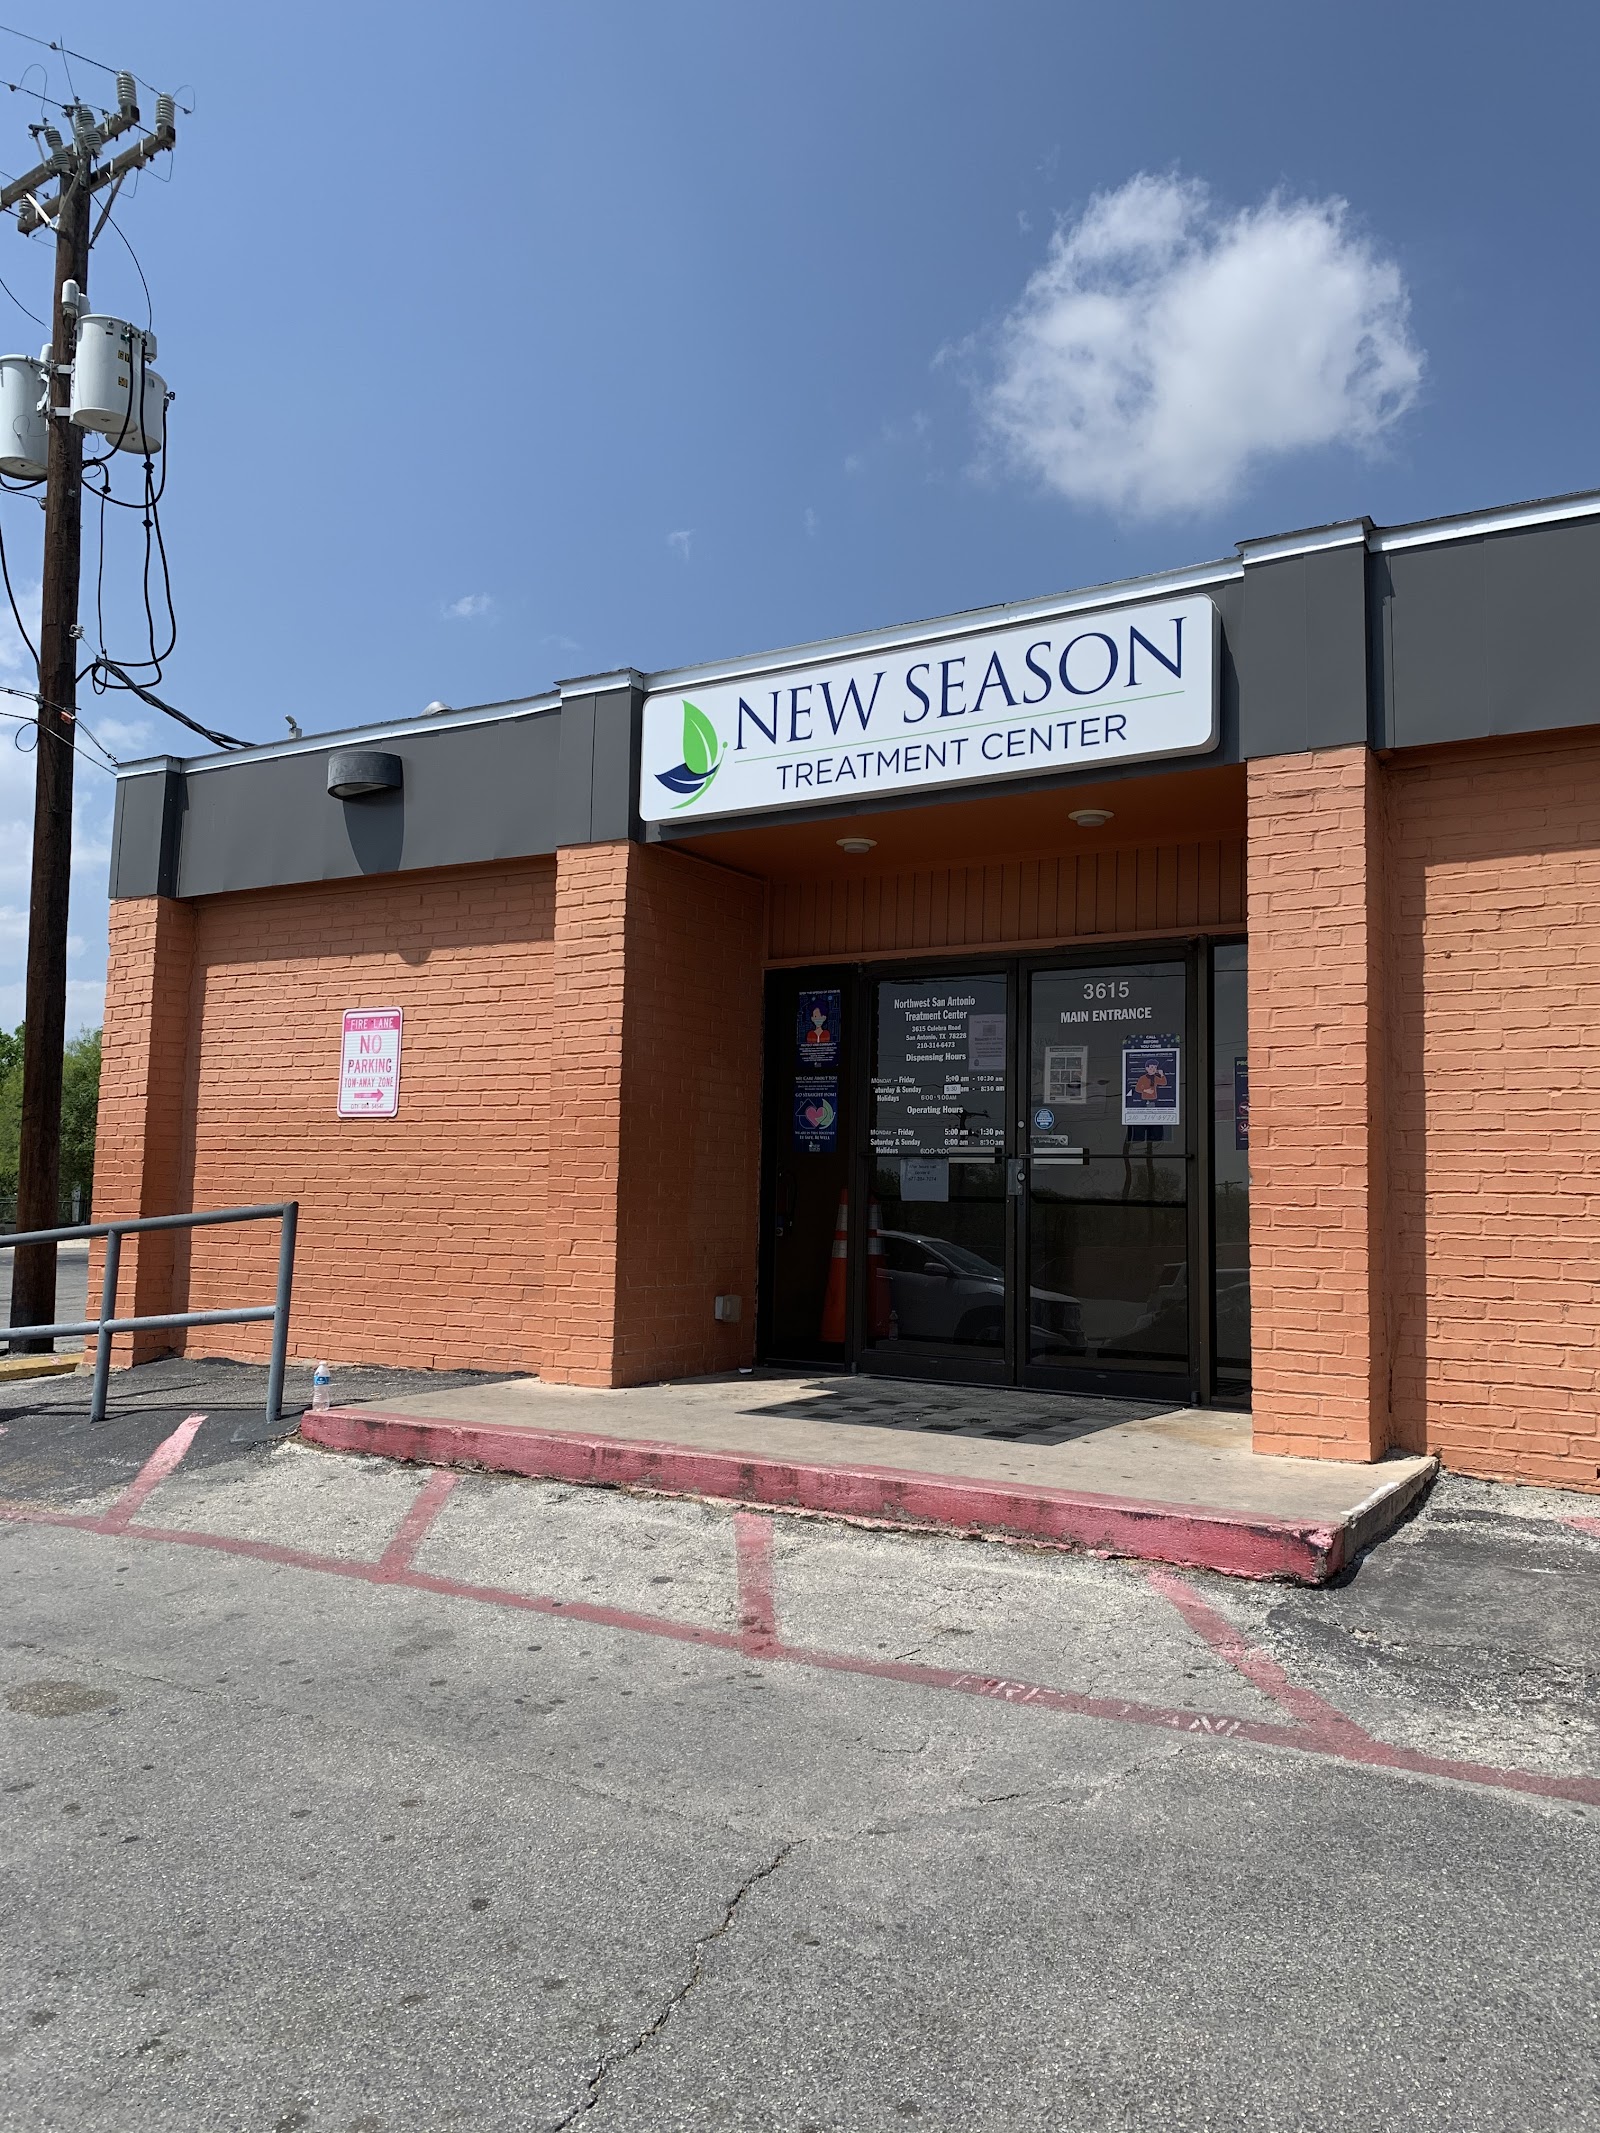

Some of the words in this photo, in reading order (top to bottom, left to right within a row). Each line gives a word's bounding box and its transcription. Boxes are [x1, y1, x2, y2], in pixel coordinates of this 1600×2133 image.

[733, 670, 886, 751] NEW
[904, 617, 1187, 723] SEASON
[776, 738, 968, 790] TREATMENT
[981, 714, 1126, 760] CENTER
[1083, 981, 1130, 1000] 3615
[894, 998, 930, 1009] Northwest
[932, 997, 945, 1007] San
[947, 996, 976, 1006] Antonio
[905, 1011, 941, 1022] Treatment
[943, 1010, 968, 1020] Center
[1060, 1010, 1089, 1023] MAIN
[1092, 1007, 1152, 1022] ENTRANCE
[350, 1019, 368, 1030] FIRE
[373, 1018, 393, 1029] LANE
[360, 1035, 382, 1054] NO
[906, 1053, 944, 1062] Dispensing
[945, 1052, 967, 1061] Hours
[348, 1058, 392, 1074] PARKING
[344, 1077, 375, 1088] TOW-AWAY
[378, 1077, 394, 1087] ZONE
[899, 1076, 916, 1084] Friday
[873, 1086, 895, 1094] aturday
[902, 1085, 922, 1093] Sunday
[907, 1106, 941, 1115] Operating
[942, 1104, 964, 1114] Hours
[898, 1128, 915, 1136] Friday
[944, 1128, 959, 1136] 5:00
[980, 1128, 993, 1136] 1:30
[870, 1138, 894, 1146] Saturday
[895, 1138, 900, 1146] &
[901, 1138, 920, 1147] Sunday
[944, 1138, 958, 1146] 6:00
